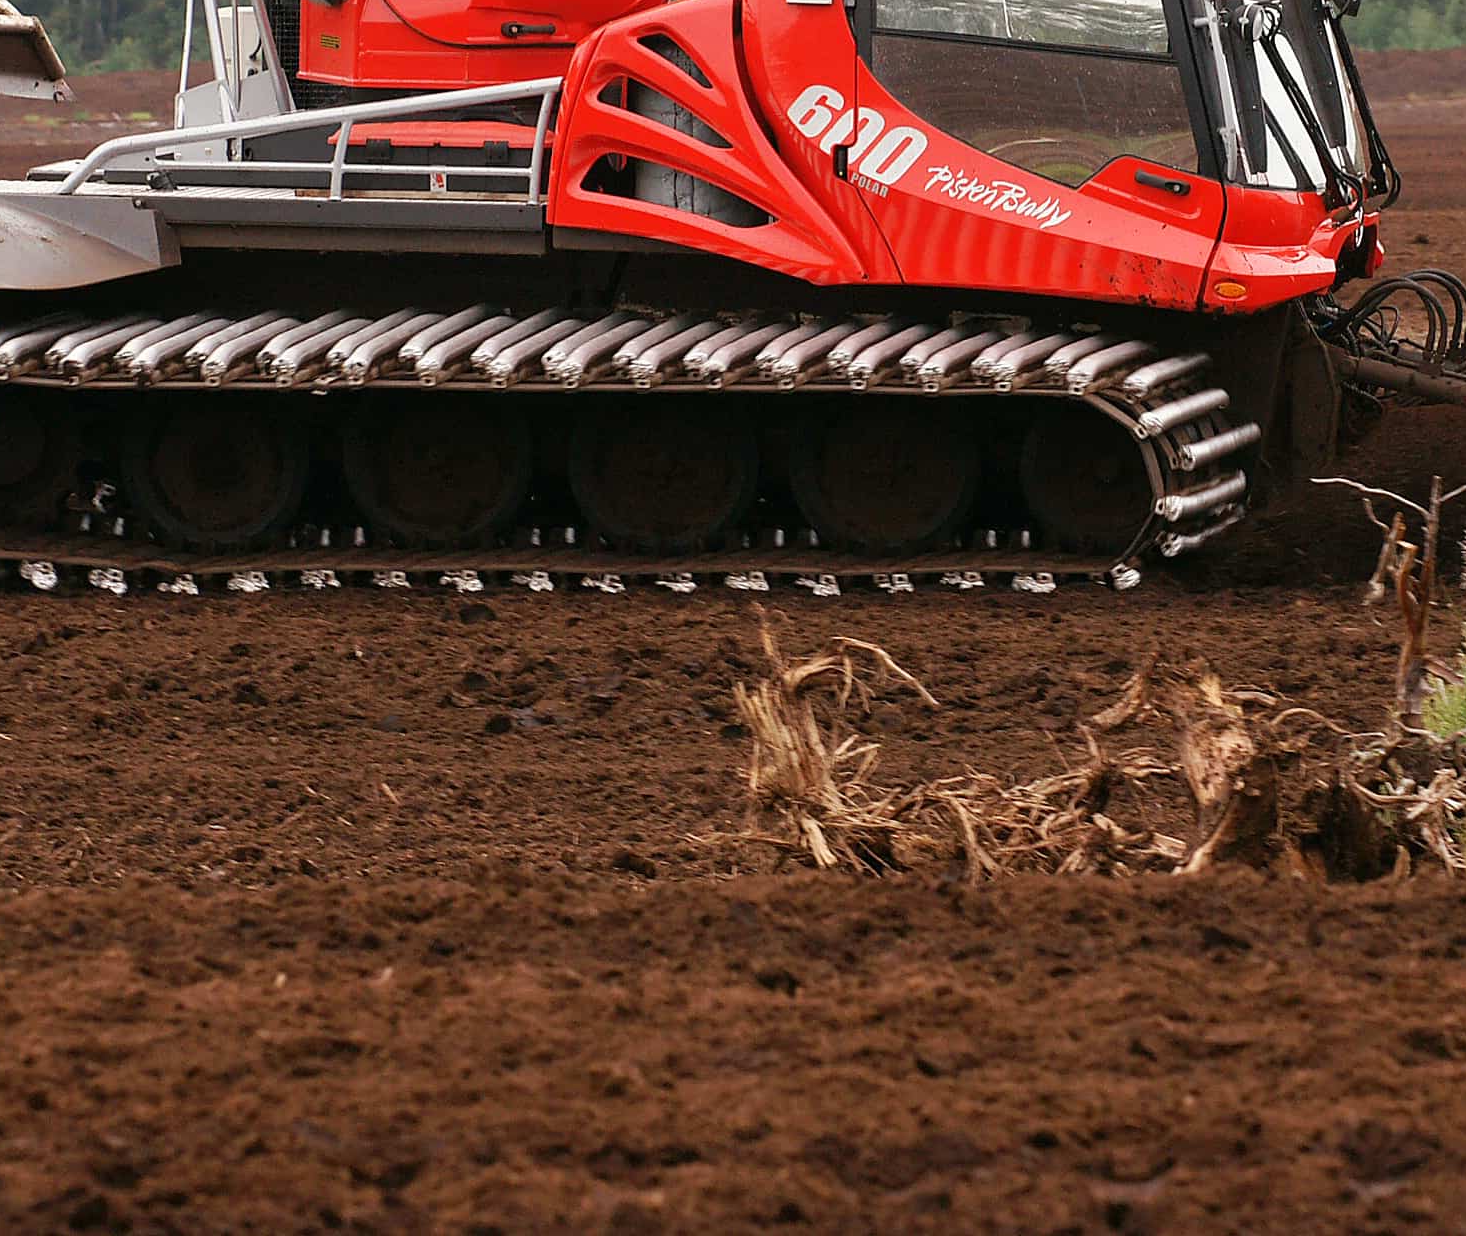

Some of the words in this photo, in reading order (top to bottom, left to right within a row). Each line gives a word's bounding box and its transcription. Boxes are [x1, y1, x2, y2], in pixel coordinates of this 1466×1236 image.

[787, 85, 928, 185] 600
[850, 172, 889, 198] POLAR
[924, 165, 1072, 229] PistenBully
